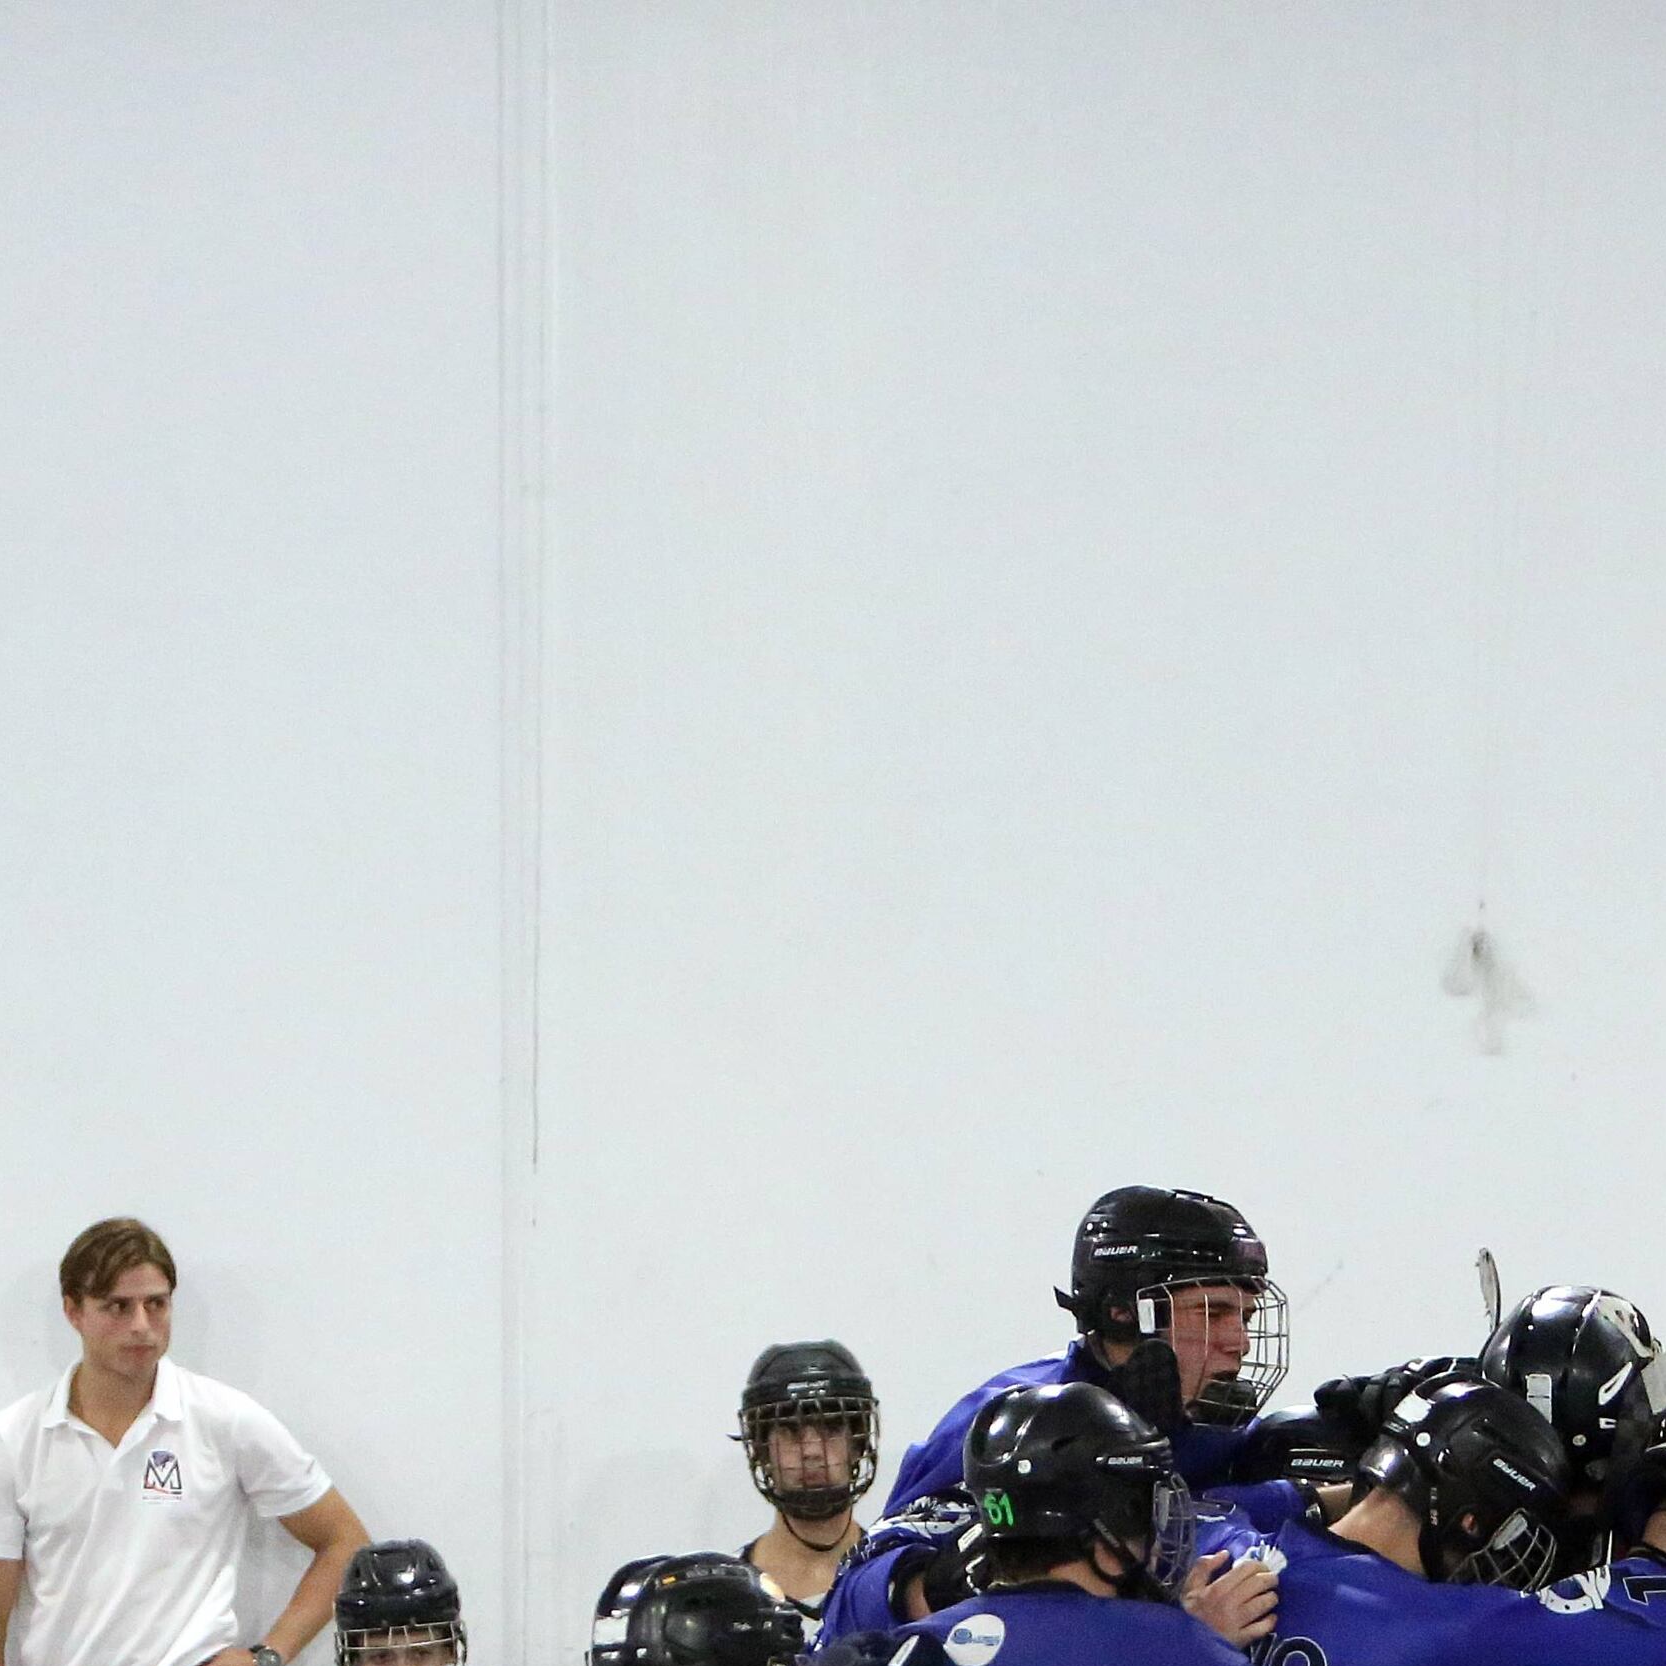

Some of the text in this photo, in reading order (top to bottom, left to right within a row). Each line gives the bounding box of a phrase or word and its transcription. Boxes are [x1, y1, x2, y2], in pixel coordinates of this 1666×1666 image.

[1093, 1244, 1139, 1257] BAUER
[1107, 1454, 1144, 1466] BAUER
[1290, 1457, 1346, 1469] BAUER
[1492, 1457, 1537, 1492] BAUER
[983, 1492, 1014, 1527] 61
